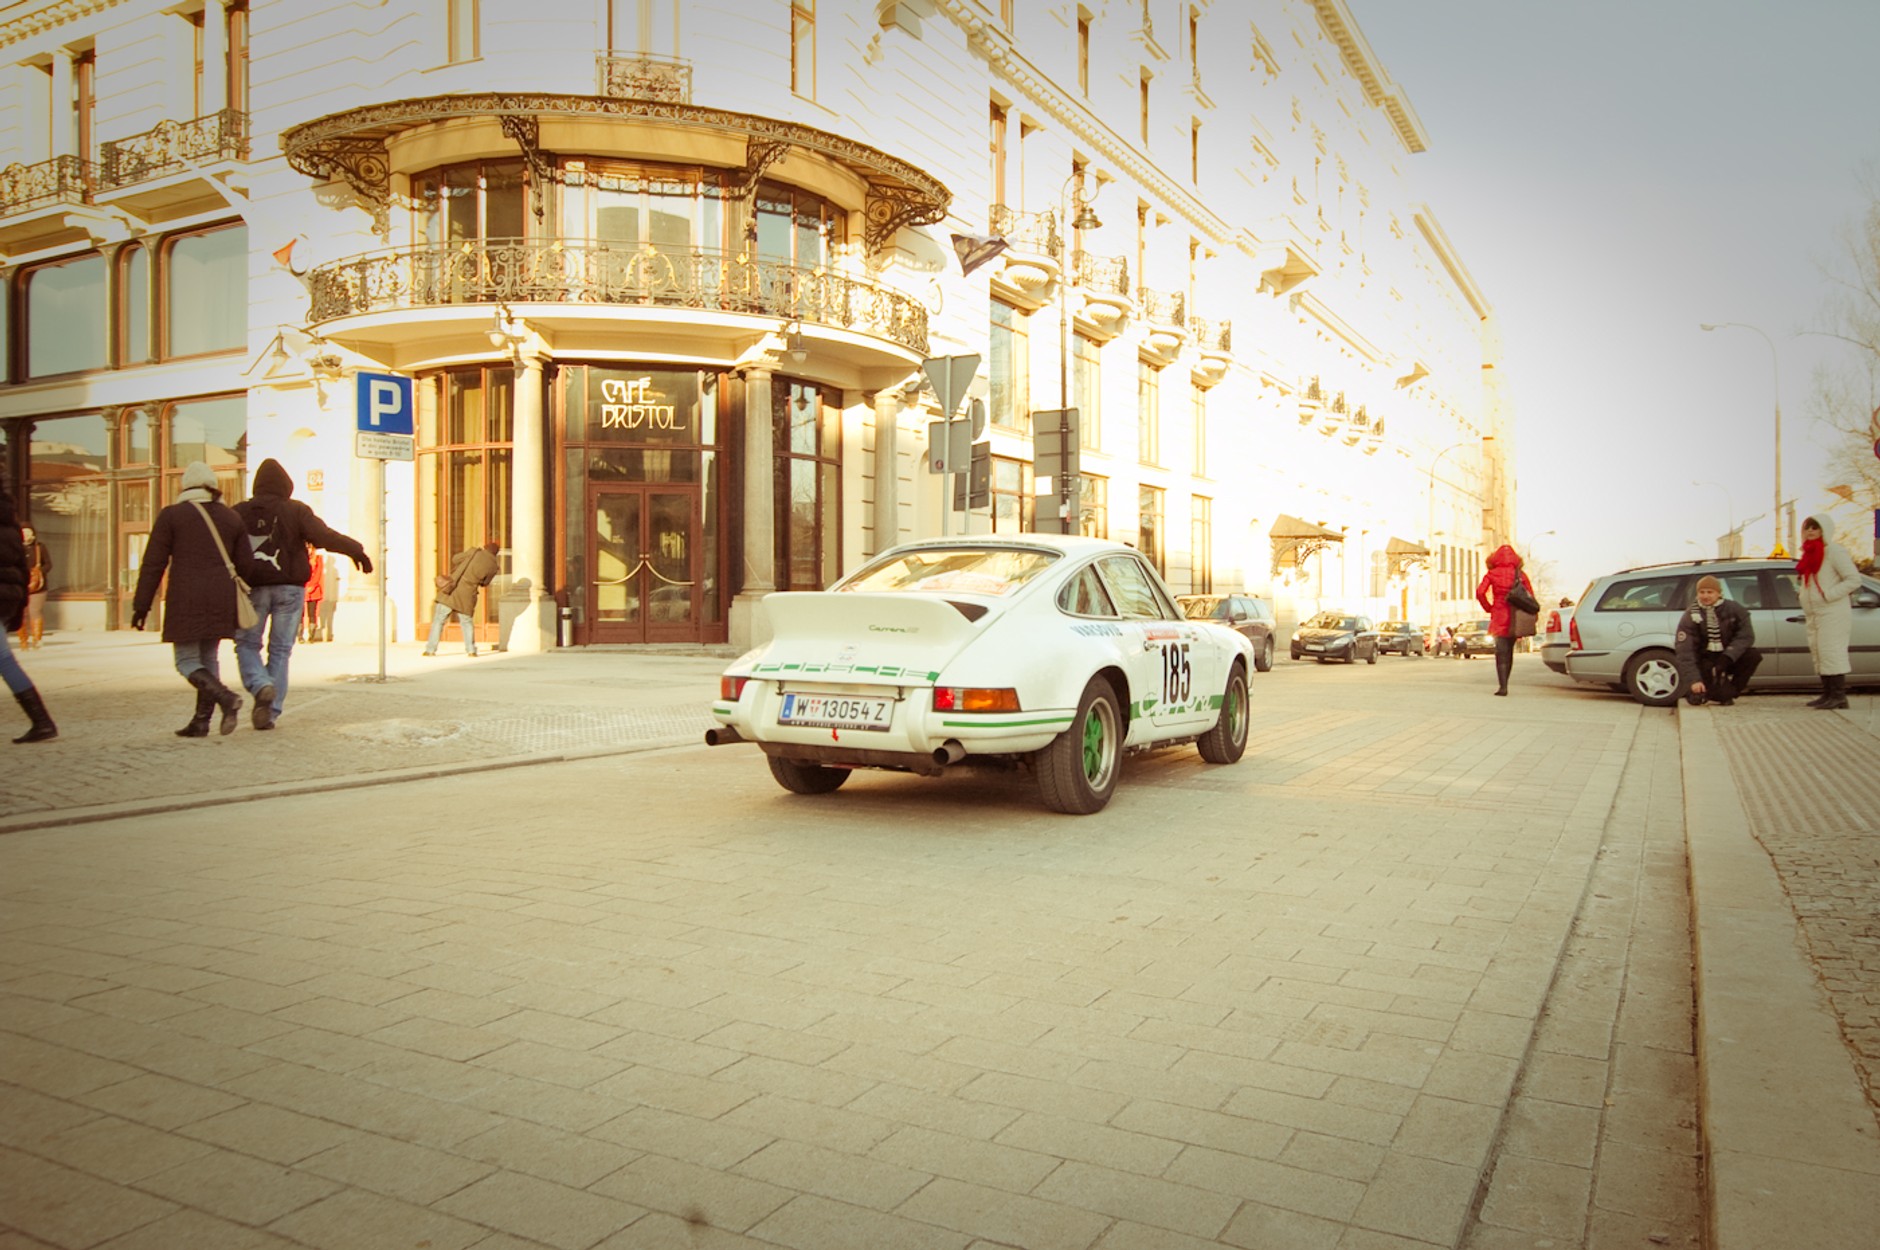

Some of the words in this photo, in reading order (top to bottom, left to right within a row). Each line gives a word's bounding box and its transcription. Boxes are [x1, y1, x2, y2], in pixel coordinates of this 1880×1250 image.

[370, 379, 402, 426] P
[601, 376, 656, 404] CAFÉ
[602, 403, 686, 430] BRISTOL
[1161, 642, 1191, 705] 185
[796, 698, 810, 716] W
[822, 699, 870, 720] 13054
[874, 703, 886, 721] Z
